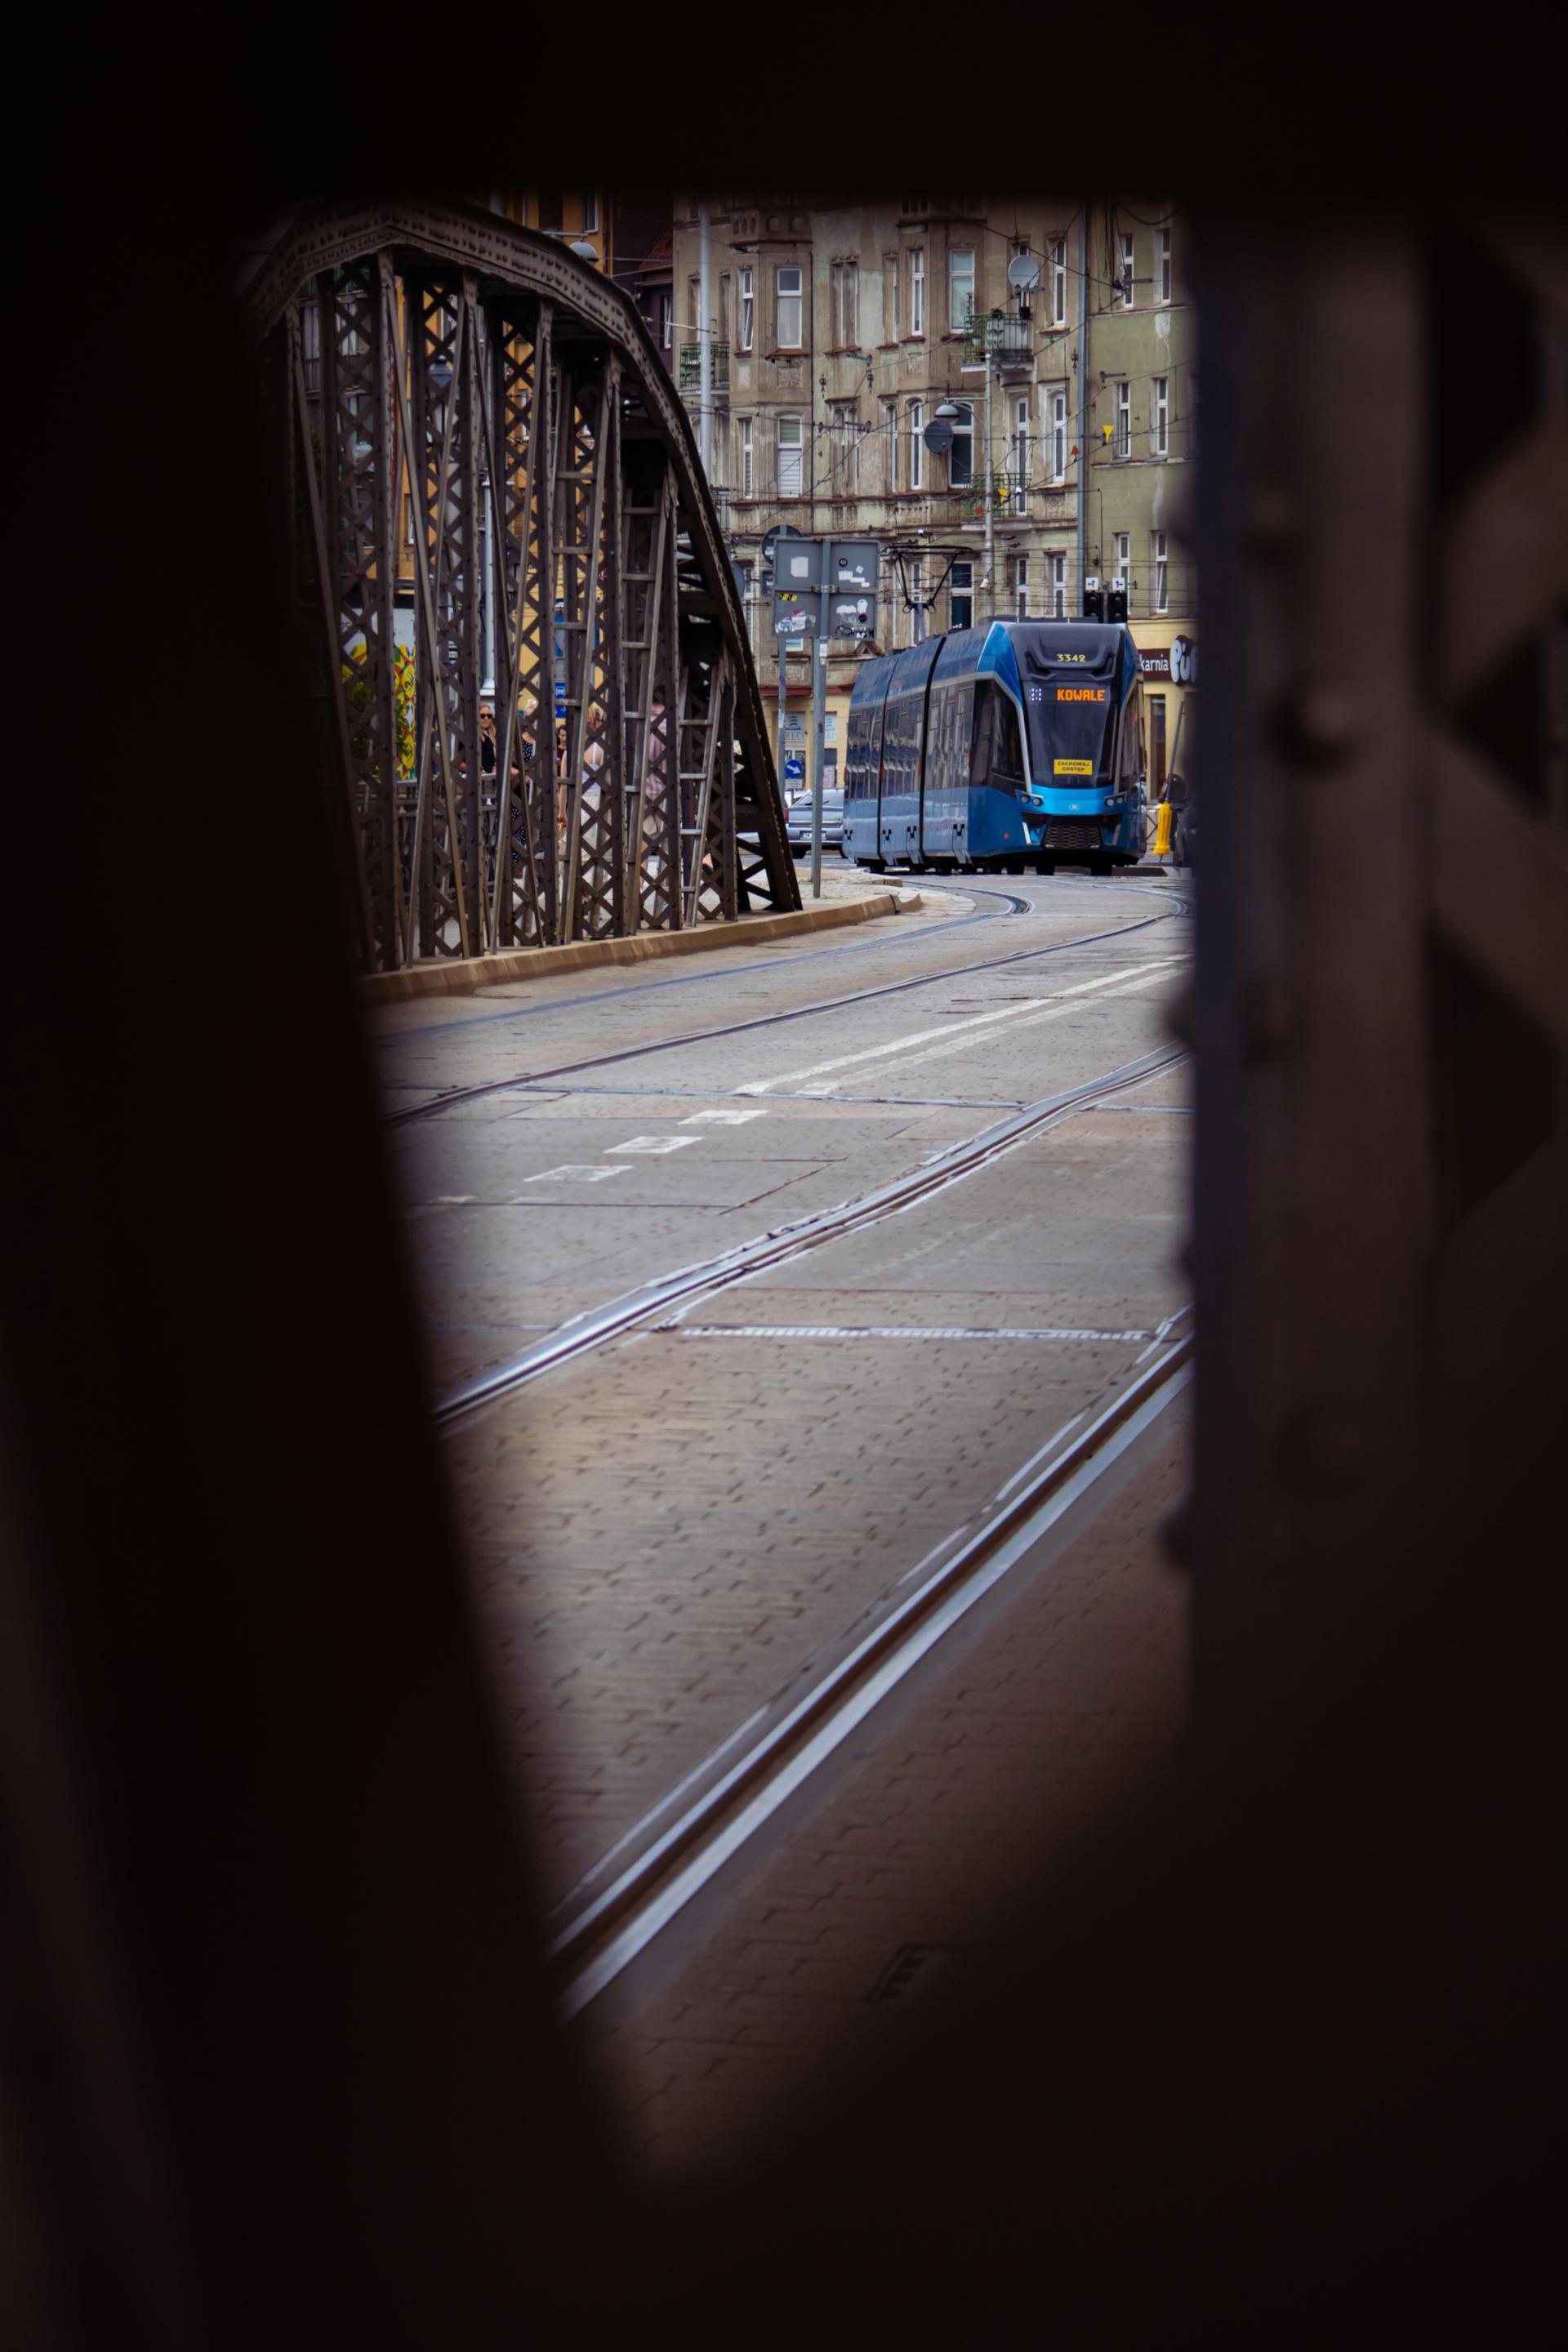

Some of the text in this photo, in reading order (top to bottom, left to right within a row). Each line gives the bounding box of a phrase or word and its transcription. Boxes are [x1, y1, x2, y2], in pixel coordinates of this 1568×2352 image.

[1057, 653, 1085, 662] 3342
[1139, 653, 1169, 671] karnia
[1057, 689, 1106, 702] KOWALE
